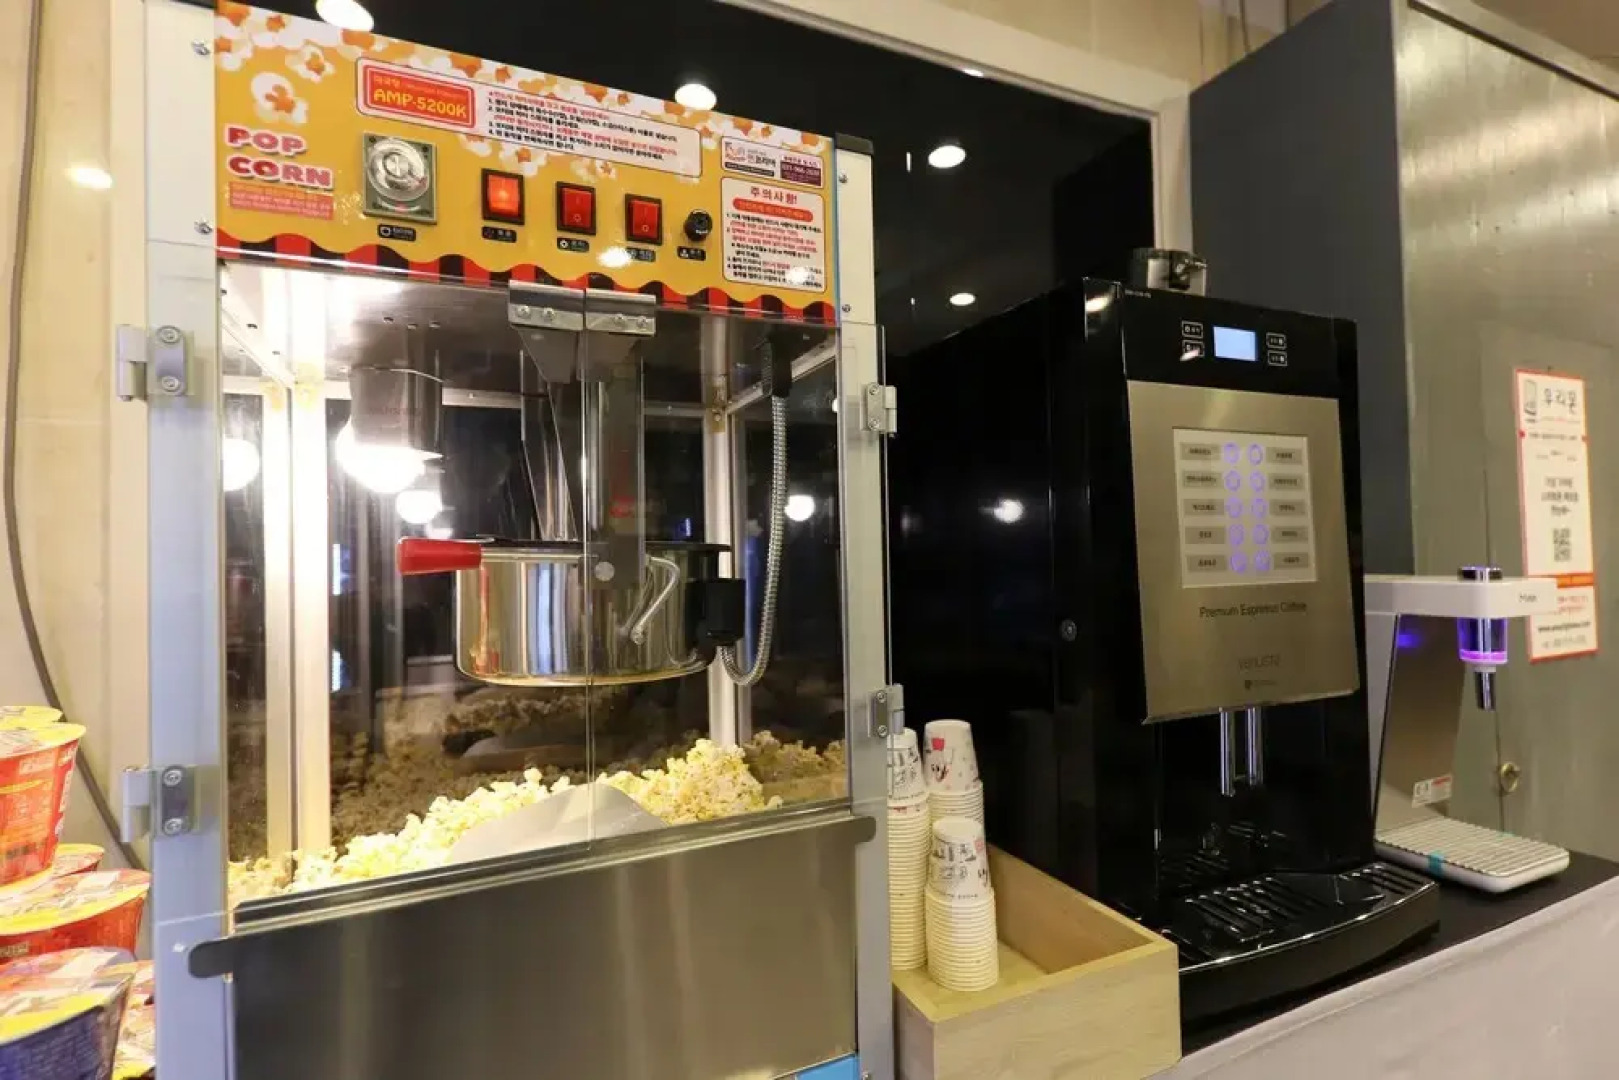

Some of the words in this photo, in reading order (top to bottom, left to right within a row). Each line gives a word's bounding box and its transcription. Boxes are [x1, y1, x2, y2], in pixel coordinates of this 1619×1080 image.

[374, 88, 468, 119] AMP-5200K
[225, 125, 306, 155] POP
[227, 155, 332, 187] CORN
